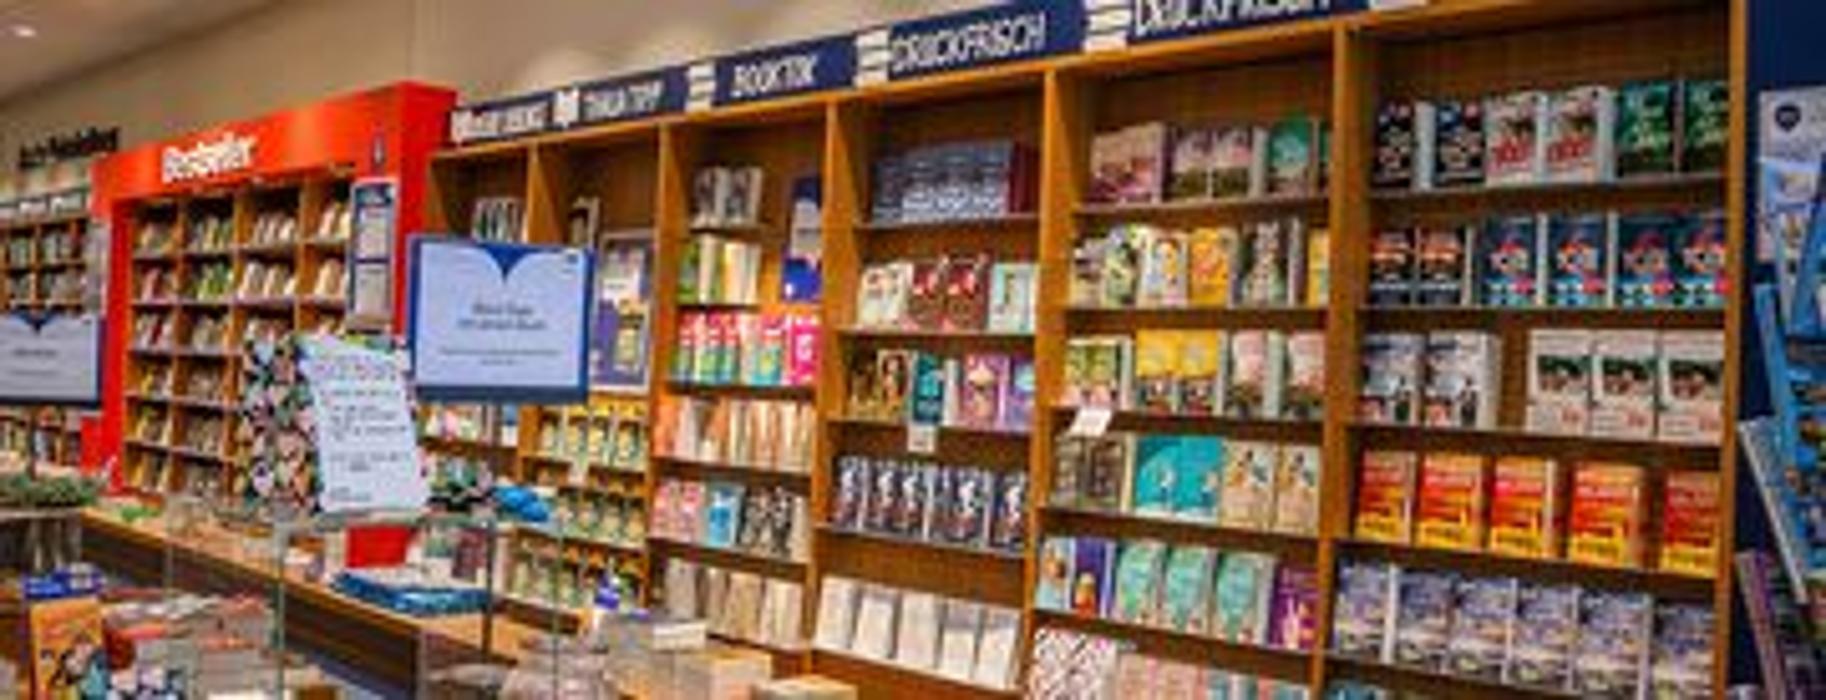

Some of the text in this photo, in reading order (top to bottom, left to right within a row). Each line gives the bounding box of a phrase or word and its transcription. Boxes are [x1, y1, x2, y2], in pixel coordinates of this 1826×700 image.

[891, 12, 1046, 72] DRUCKFRISCH
[1136, 0, 1331, 37] DRUCKF
[161, 131, 256, 184] Bestseller
